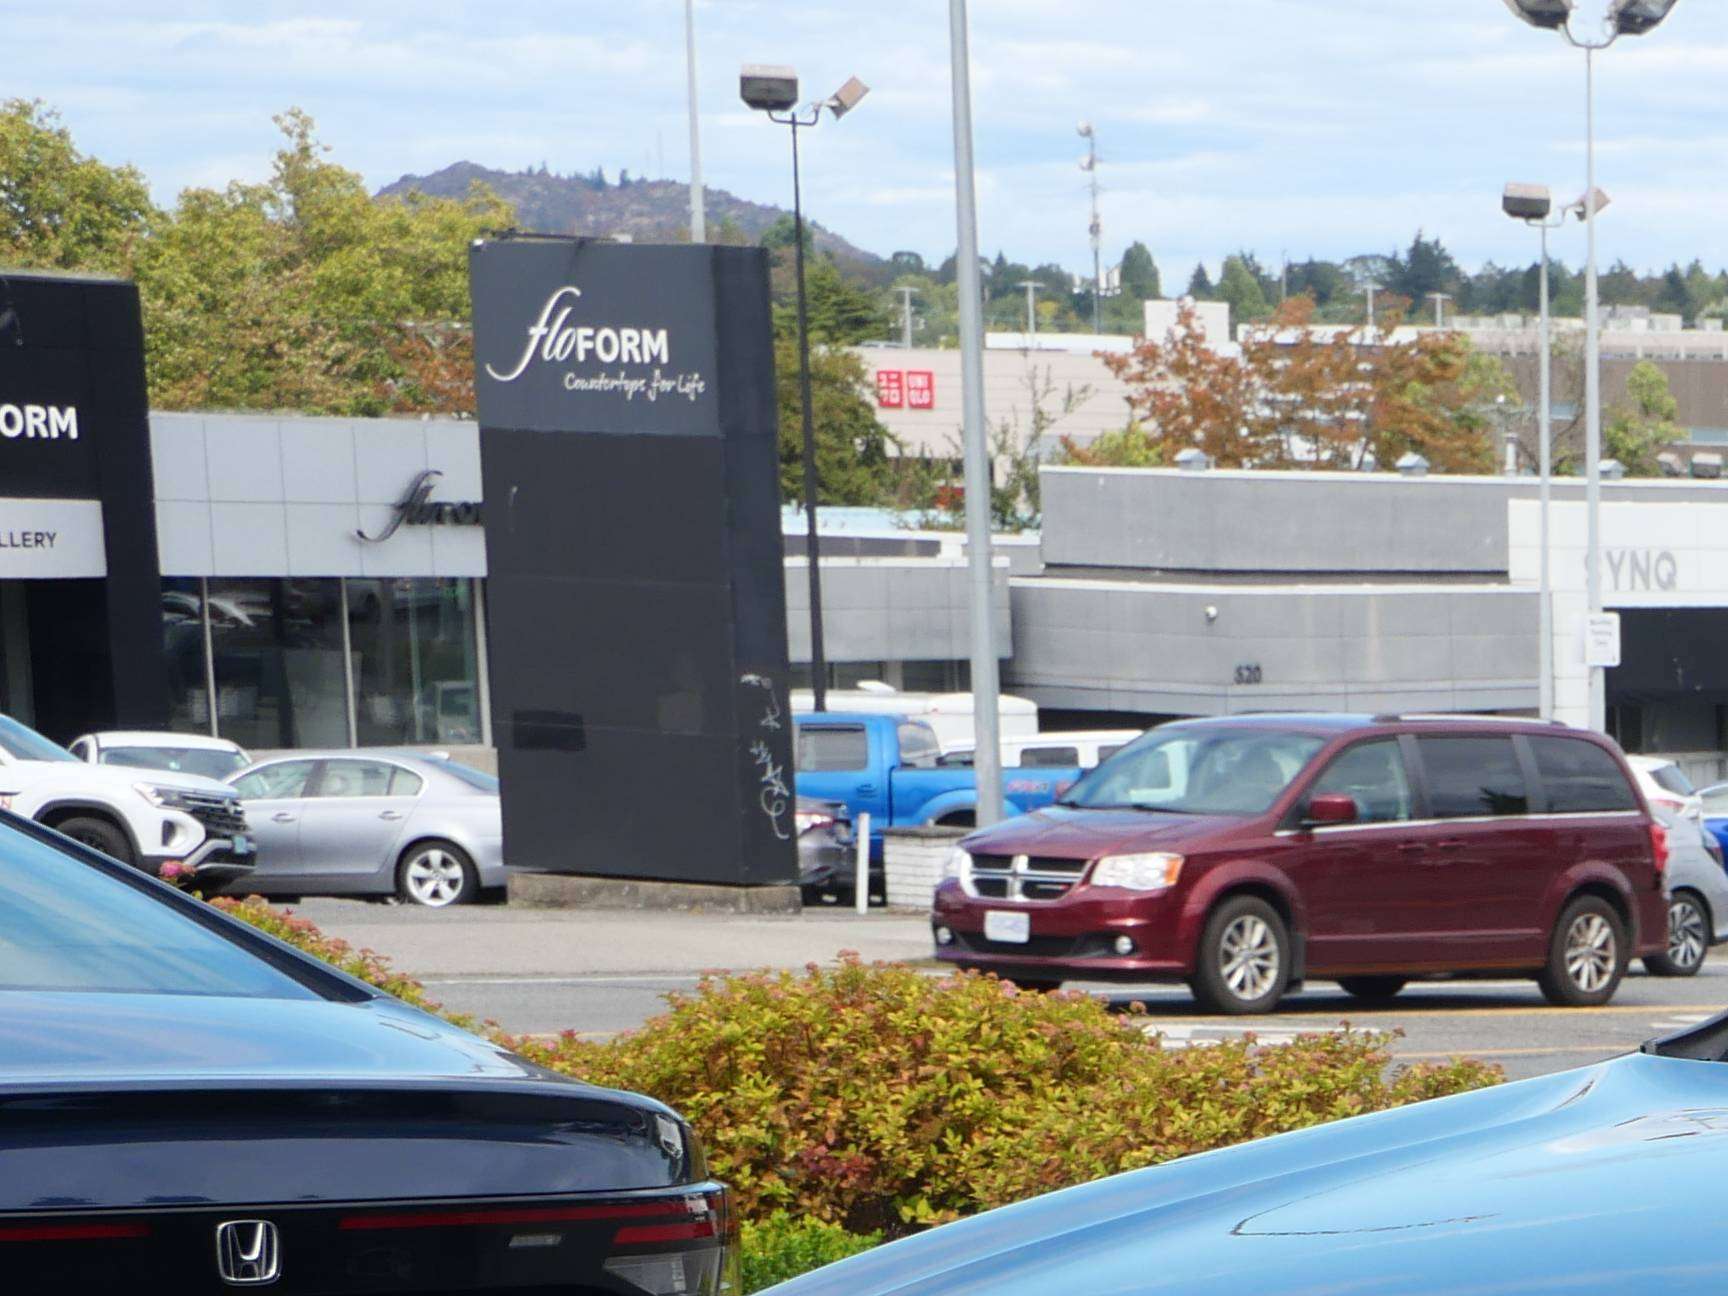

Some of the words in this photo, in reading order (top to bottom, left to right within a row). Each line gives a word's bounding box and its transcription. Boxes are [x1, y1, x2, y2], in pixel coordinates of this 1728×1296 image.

[564, 371, 646, 400] Countertops
[648, 368, 676, 401] for
[677, 373, 705, 400] Life
